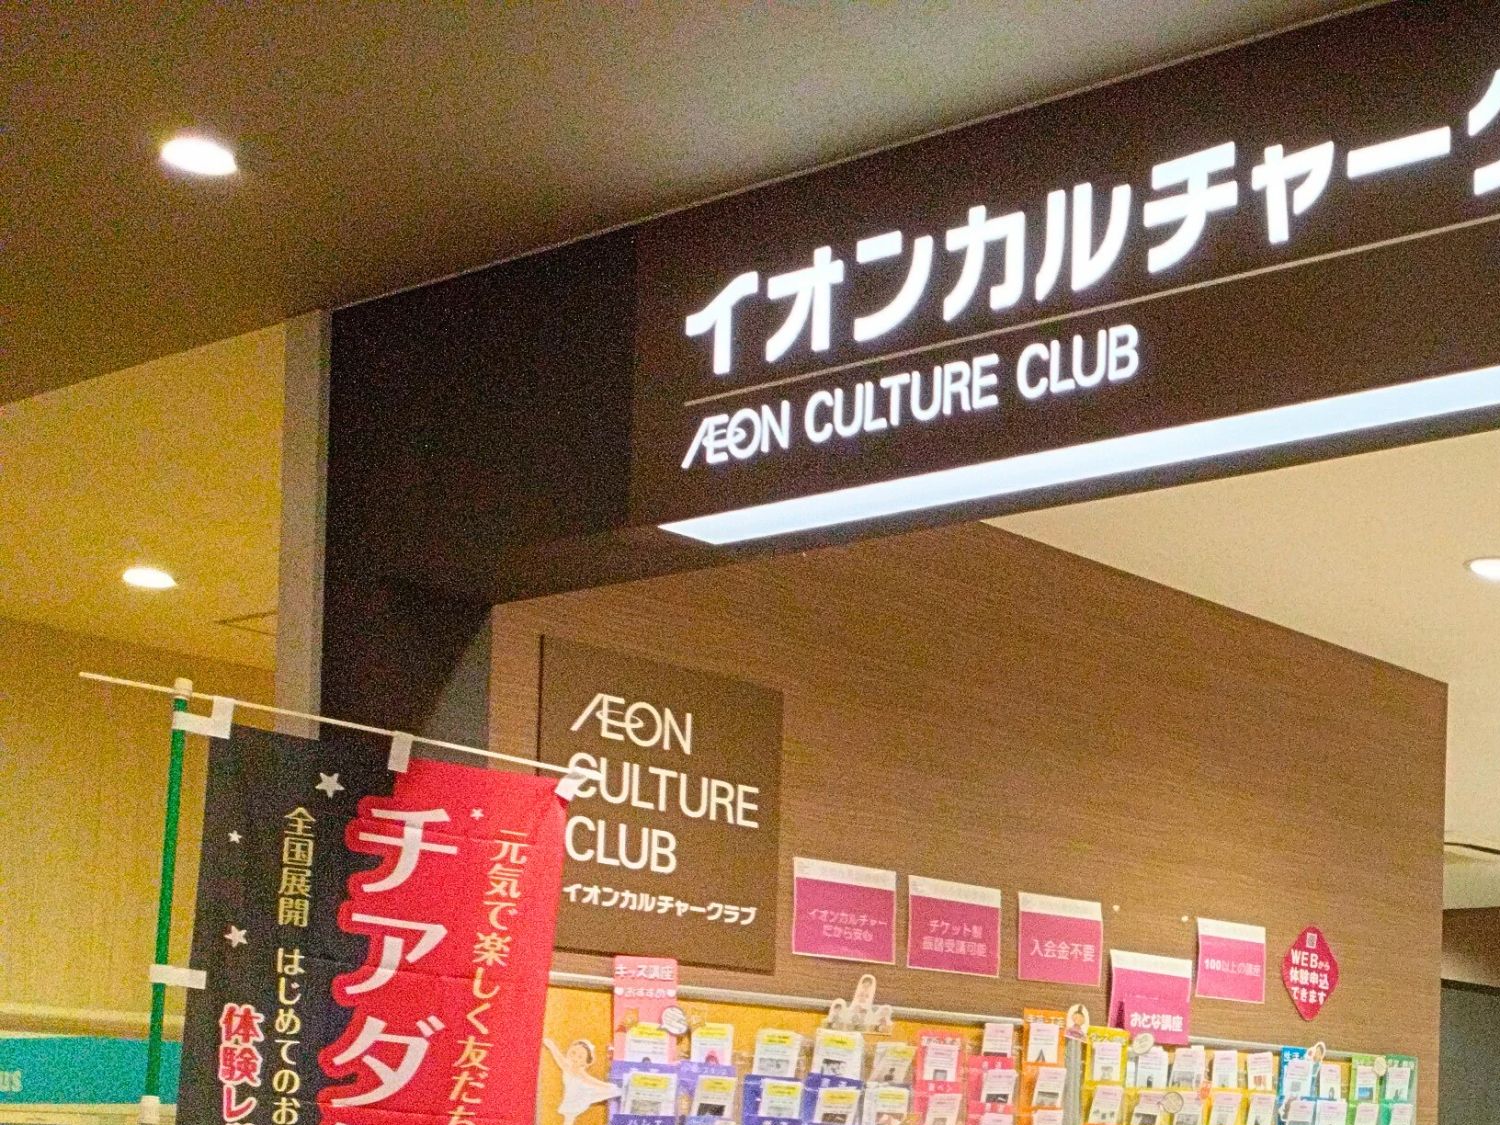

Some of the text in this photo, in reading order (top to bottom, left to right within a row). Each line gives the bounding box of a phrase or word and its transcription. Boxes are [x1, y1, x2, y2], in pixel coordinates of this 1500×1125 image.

[804, 353, 999, 445] CULTURE
[1016, 323, 1140, 400] CLUB
[568, 751, 759, 829] CULTURE
[277, 804, 317, 928] 全国展開
[565, 815, 677, 875] CLUB
[562, 883, 757, 926] イオンカルチャークラブ
[1029, 937, 1096, 964] 入会金不要
[1129, 1011, 1184, 1033] おとな講座
